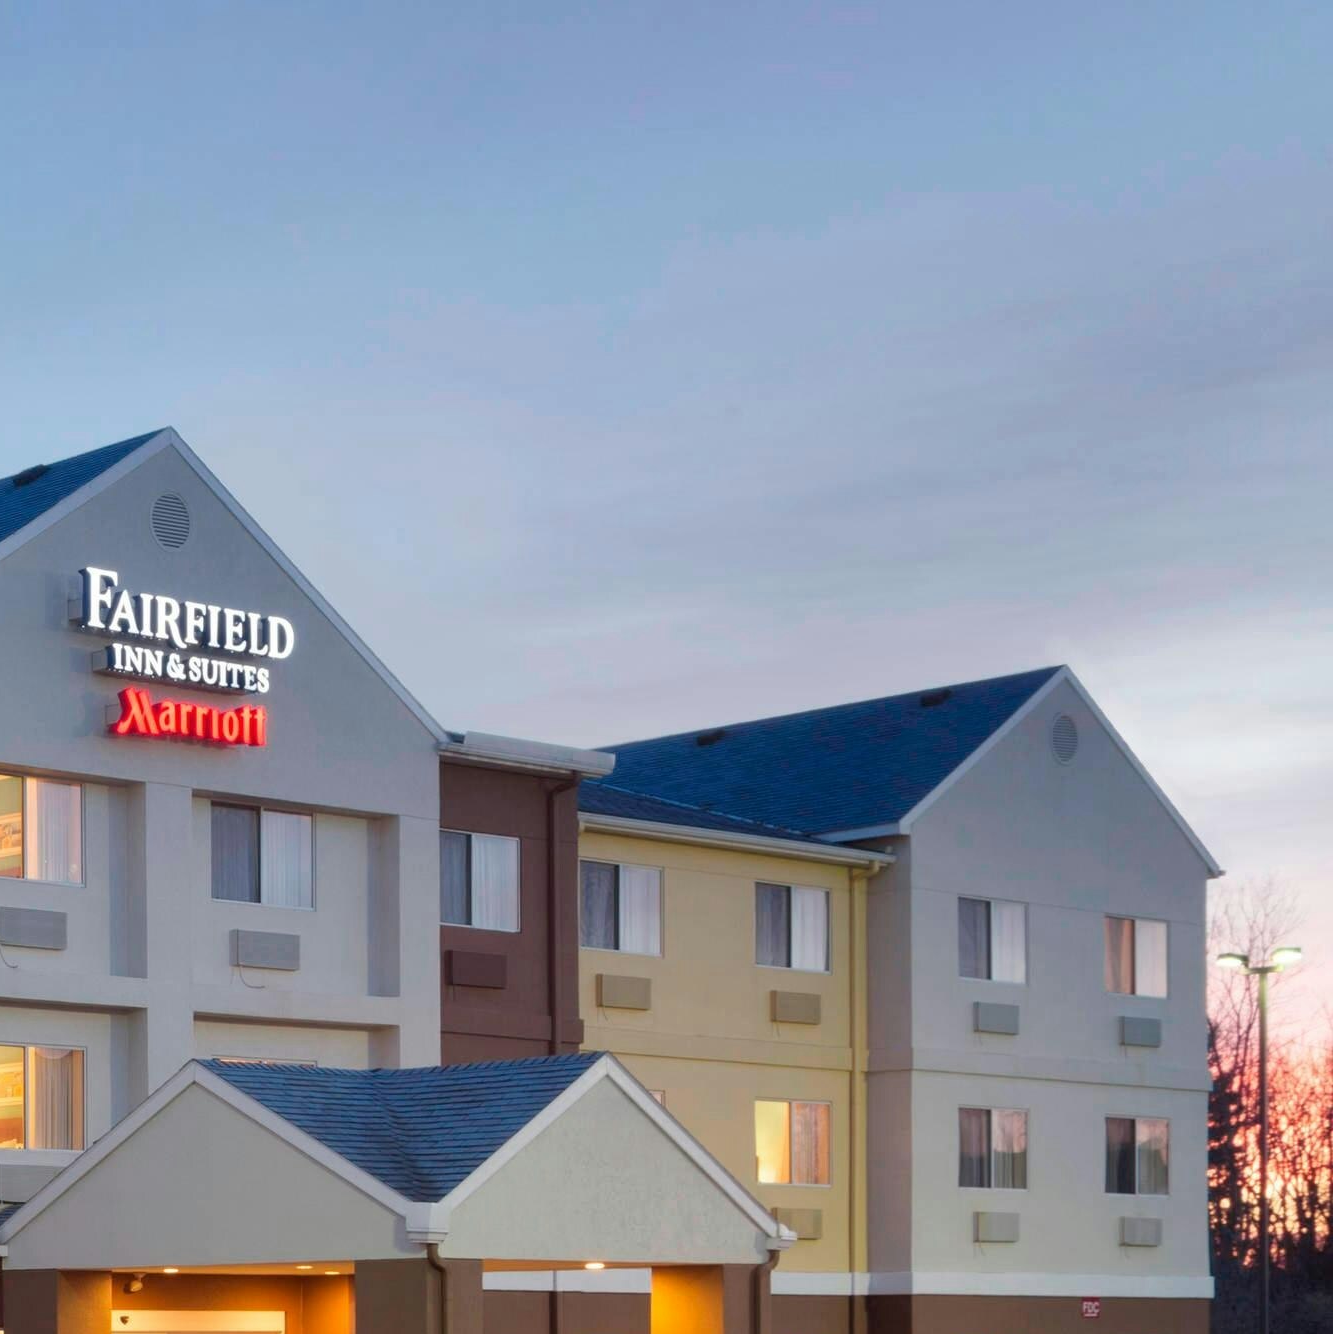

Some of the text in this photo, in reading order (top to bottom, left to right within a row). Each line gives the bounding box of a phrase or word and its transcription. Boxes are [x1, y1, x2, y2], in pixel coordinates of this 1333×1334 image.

[85, 566, 295, 660] FAIRFIELD
[111, 643, 270, 693] INN & SUITES
[115, 687, 267, 746] Marriott
